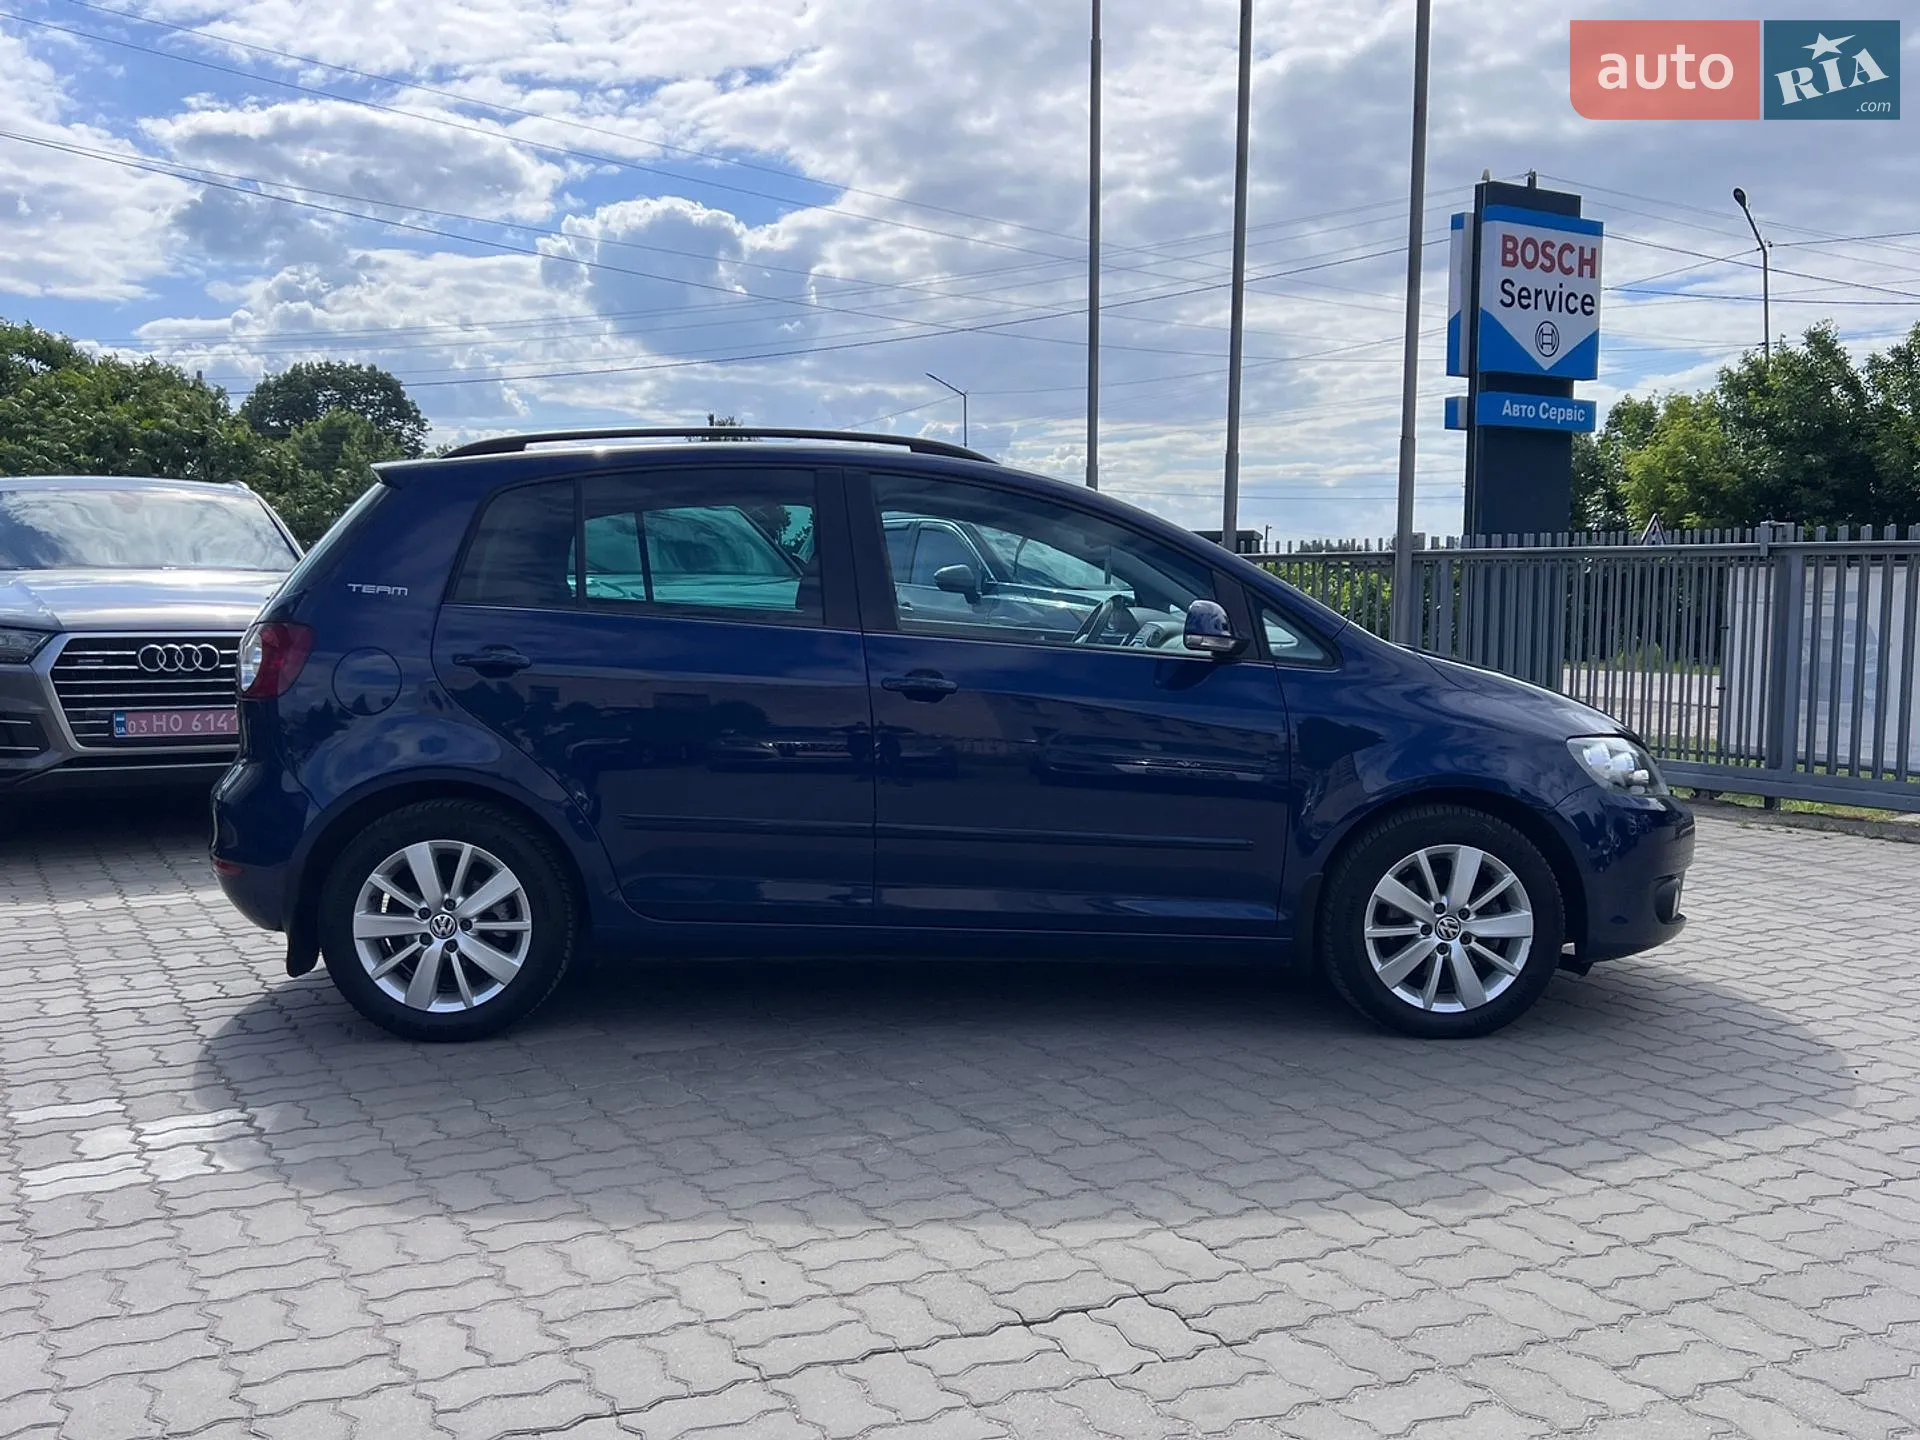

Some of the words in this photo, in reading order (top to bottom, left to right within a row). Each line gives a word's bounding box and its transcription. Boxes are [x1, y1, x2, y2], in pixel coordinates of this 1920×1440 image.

[1501, 233, 1598, 280] BOSCH
[1499, 278, 1596, 317] Service
[1502, 399, 1536, 418] Авто
[1538, 402, 1586, 425] Сервіс
[347, 583, 409, 596] TEAM
[128, 720, 148, 734] 03
